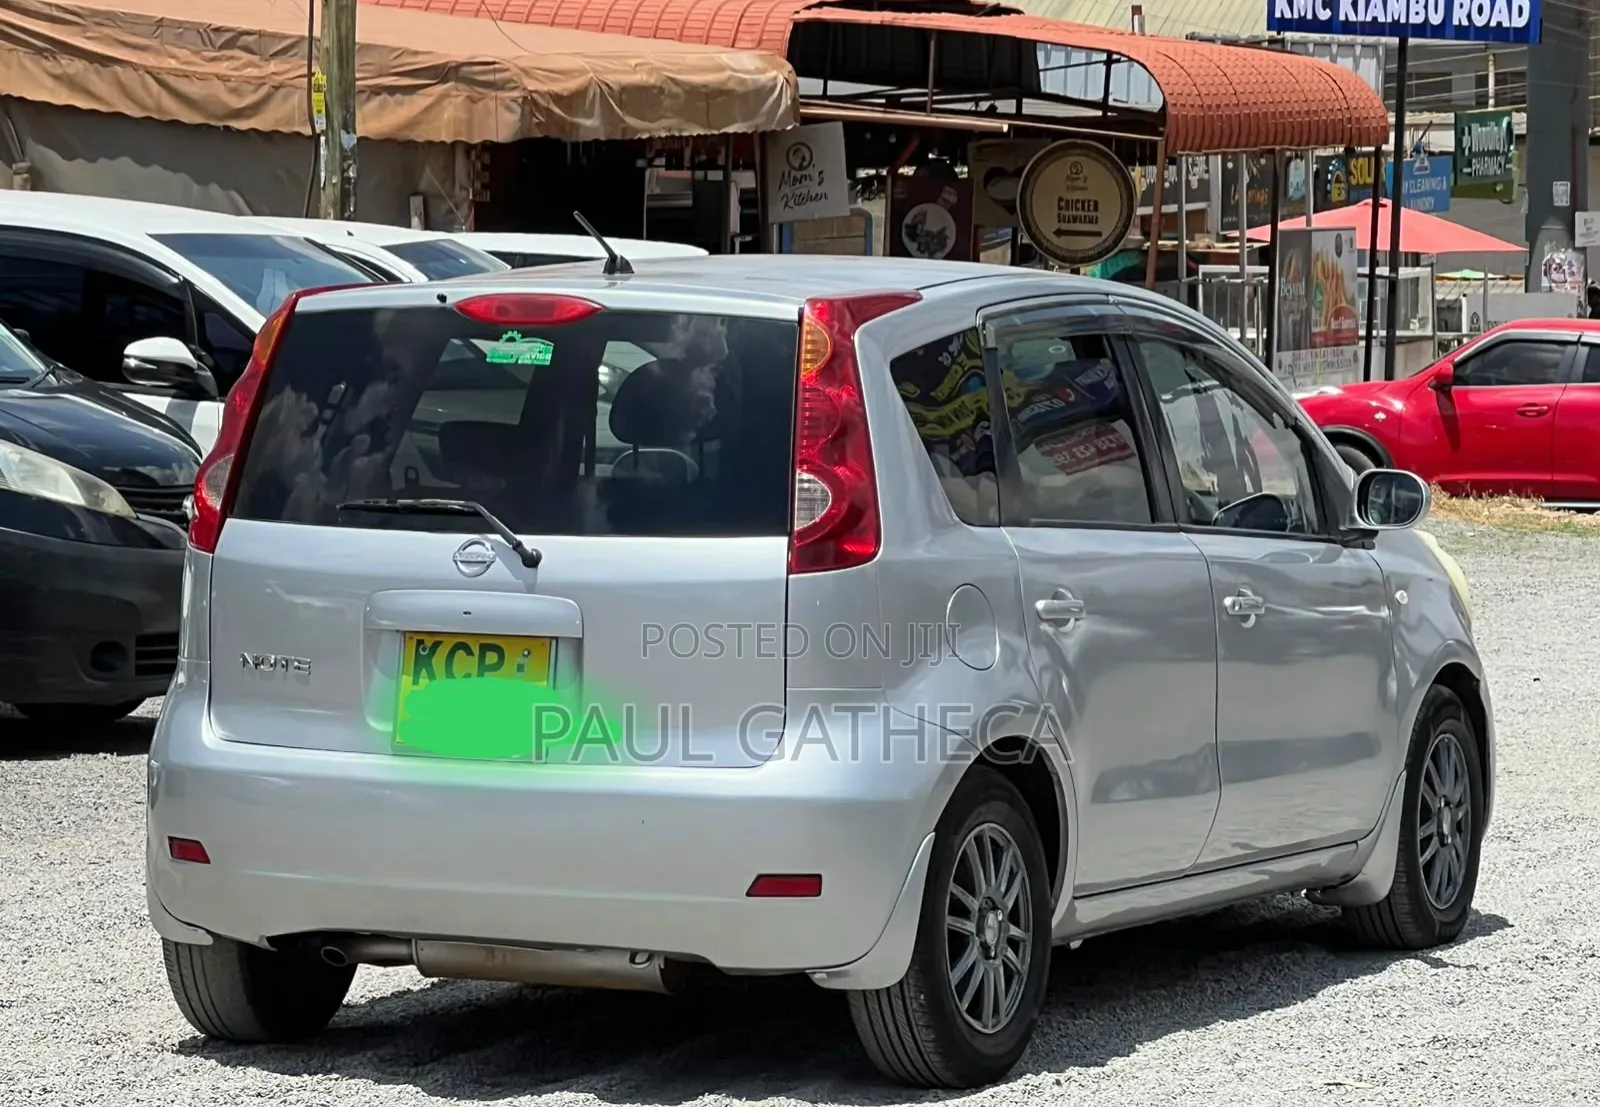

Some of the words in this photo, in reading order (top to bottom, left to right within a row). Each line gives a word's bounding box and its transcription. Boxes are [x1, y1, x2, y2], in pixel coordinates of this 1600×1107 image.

[1274, 0, 1332, 20] KMC
[1339, 0, 1445, 26] KIAMBU
[1453, 0, 1531, 28] ROAD
[778, 164, 825, 191] Mom's
[1472, 156, 1505, 177] PHARMACY
[781, 189, 829, 211] Kitchen
[239, 652, 311, 676] NOTE
